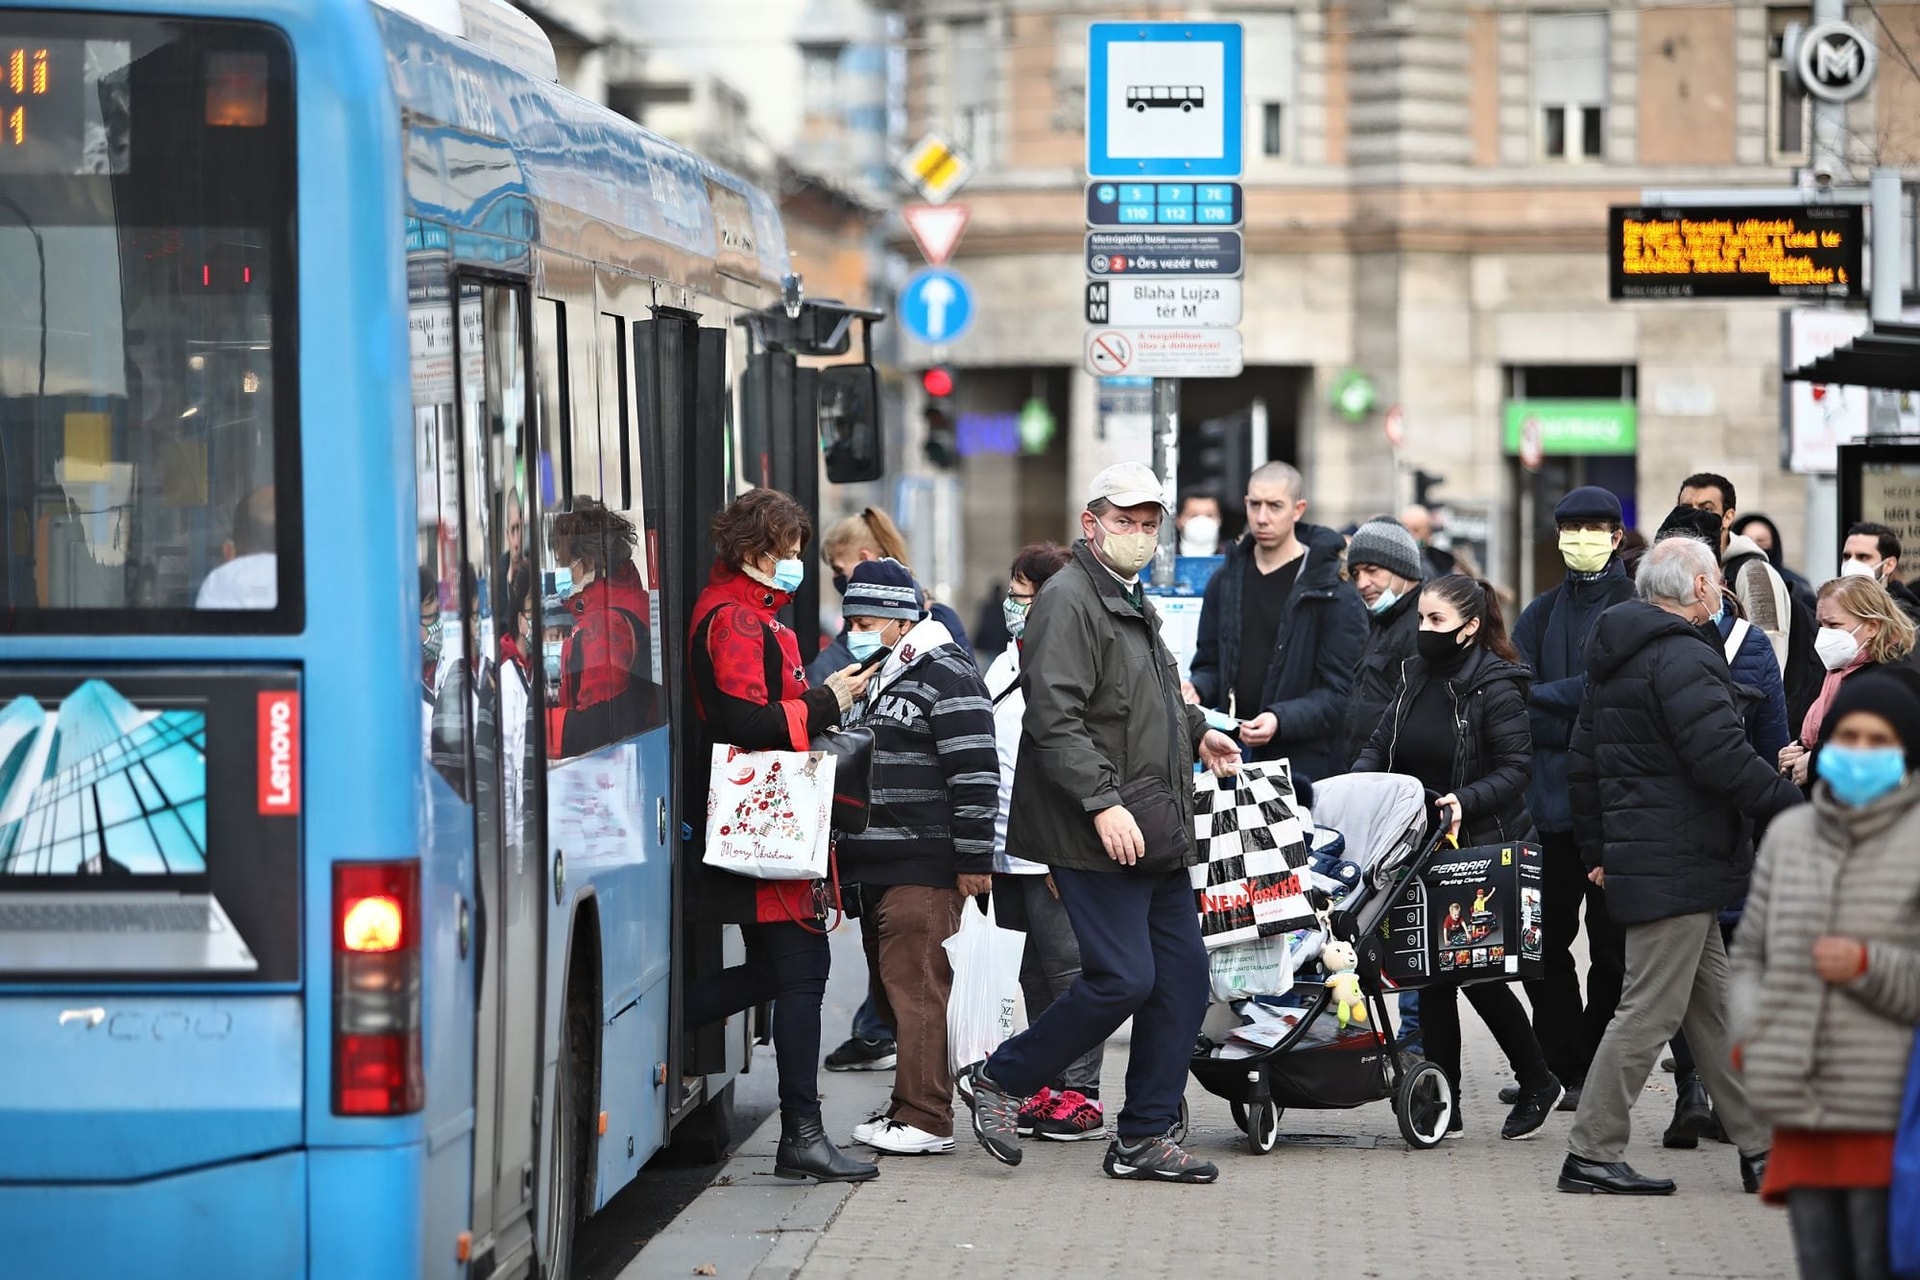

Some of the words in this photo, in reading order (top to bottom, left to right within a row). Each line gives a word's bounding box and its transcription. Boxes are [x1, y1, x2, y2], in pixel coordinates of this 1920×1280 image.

[1132, 188, 1142, 200] 5
[1171, 188, 1181, 200] 7
[1126, 208, 1148, 220] 110
[1165, 208, 1187, 220] 112
[1159, 256, 1191, 269] vezér
[1194, 257, 1219, 269] tere
[1089, 285, 1107, 302] M
[1133, 286, 1175, 300] Blaha
[1180, 286, 1220, 302] Lujza
[1089, 304, 1107, 321] M
[1156, 305, 1177, 318] tér
[1182, 305, 1197, 318] M
[266, 701, 291, 805] Lenovo
[721, 841, 752, 861] Merry
[754, 841, 795, 860] Christmas
[1428, 859, 1492, 875] FERRARI
